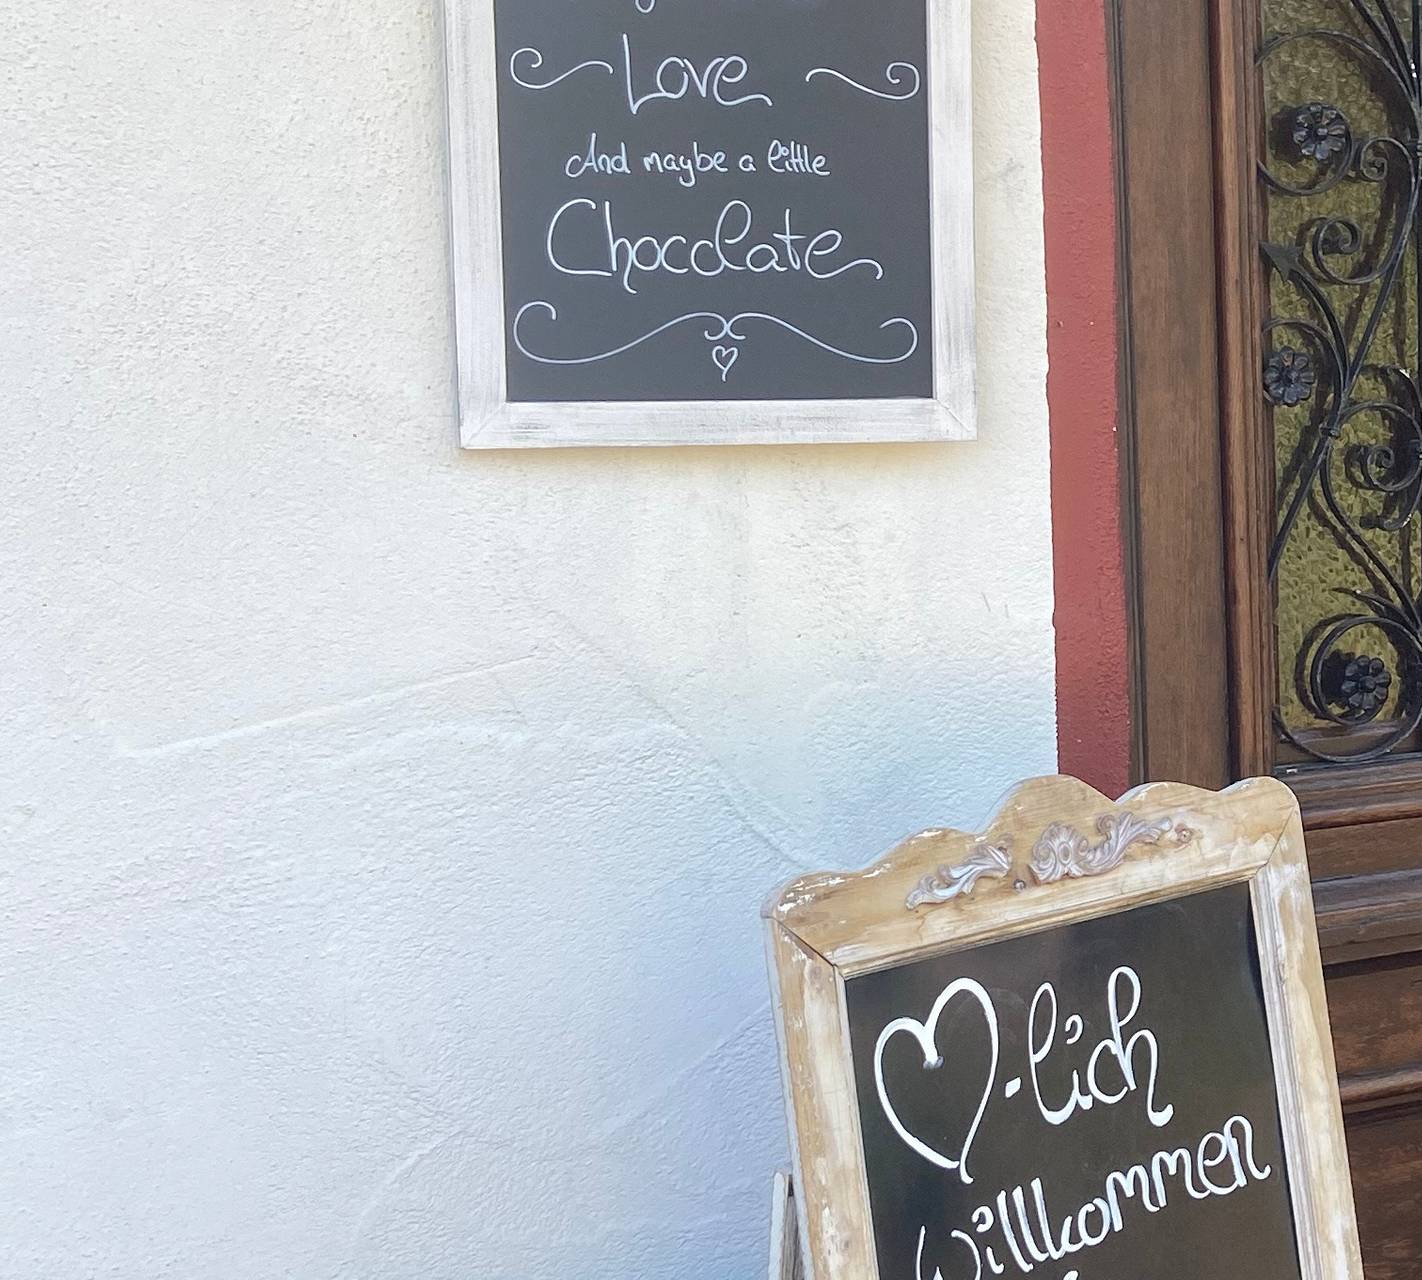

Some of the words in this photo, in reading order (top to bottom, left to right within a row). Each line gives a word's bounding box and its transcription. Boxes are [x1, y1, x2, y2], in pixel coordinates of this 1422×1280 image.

[621, 33, 773, 115] Love
[564, 132, 632, 178] And
[642, 141, 729, 188] maybe
[738, 154, 757, 172] a
[767, 139, 831, 176] little
[546, 198, 884, 294] Chocolate
